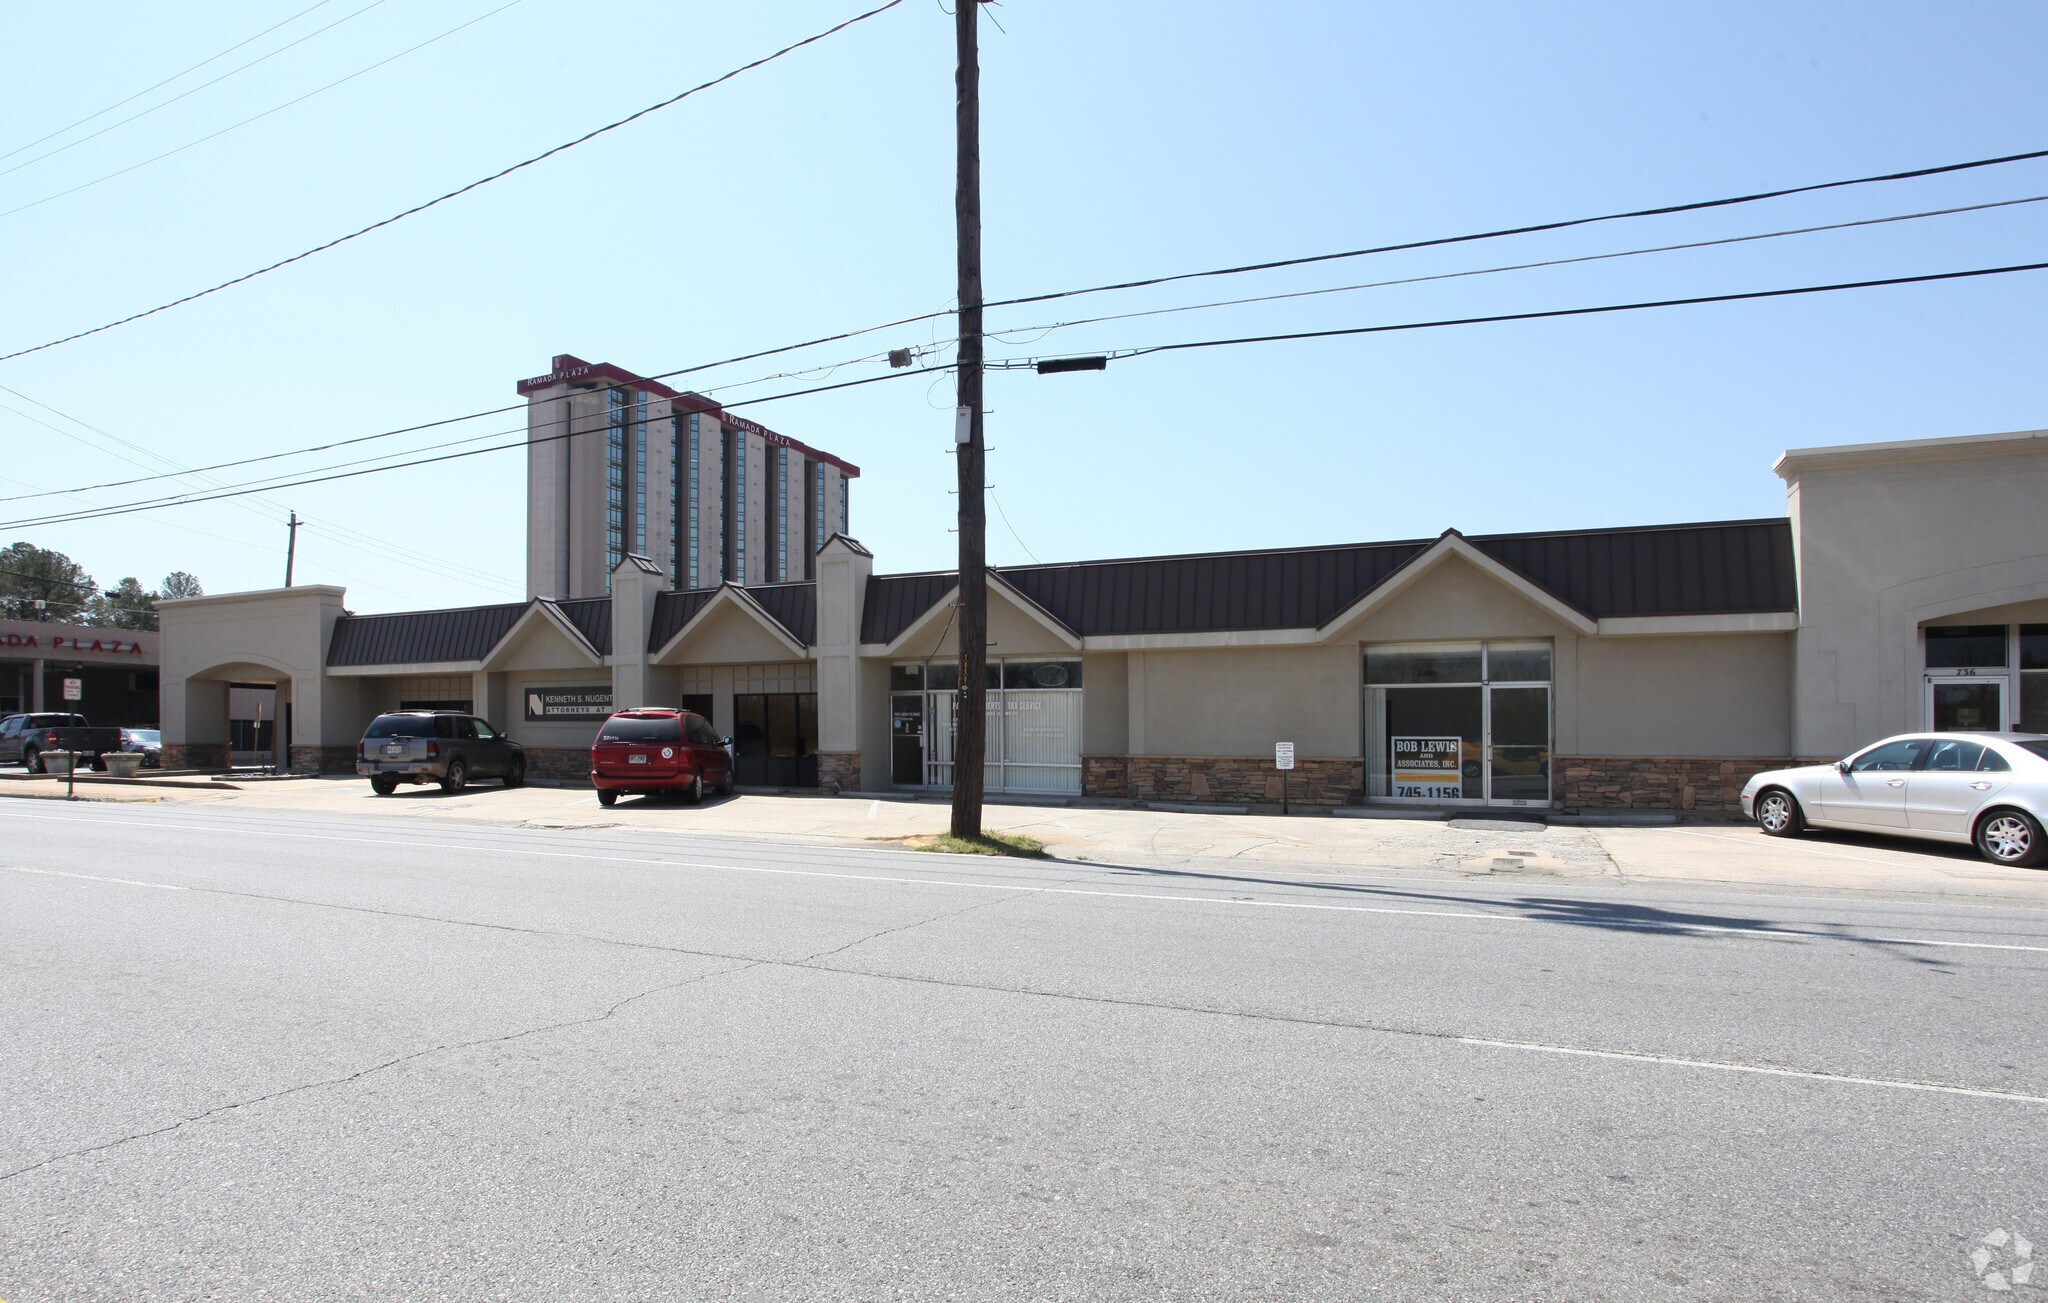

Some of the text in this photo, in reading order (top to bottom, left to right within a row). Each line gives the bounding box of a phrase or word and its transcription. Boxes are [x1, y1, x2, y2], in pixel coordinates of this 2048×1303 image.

[527, 367, 589, 386] RAMADA PLAZA
[729, 414, 791, 447] RAMADA PLAZA
[53, 636, 142, 655] PLAZA
[545, 695, 576, 704] KENNETH
[577, 695, 584, 703] S.
[1008, 701, 1018, 709] TAX
[1019, 701, 1042, 710] SERVICE
[1396, 741, 1457, 752] BOB LEWIS
[1397, 760, 1457, 768] ASSOCIATES, INC.
